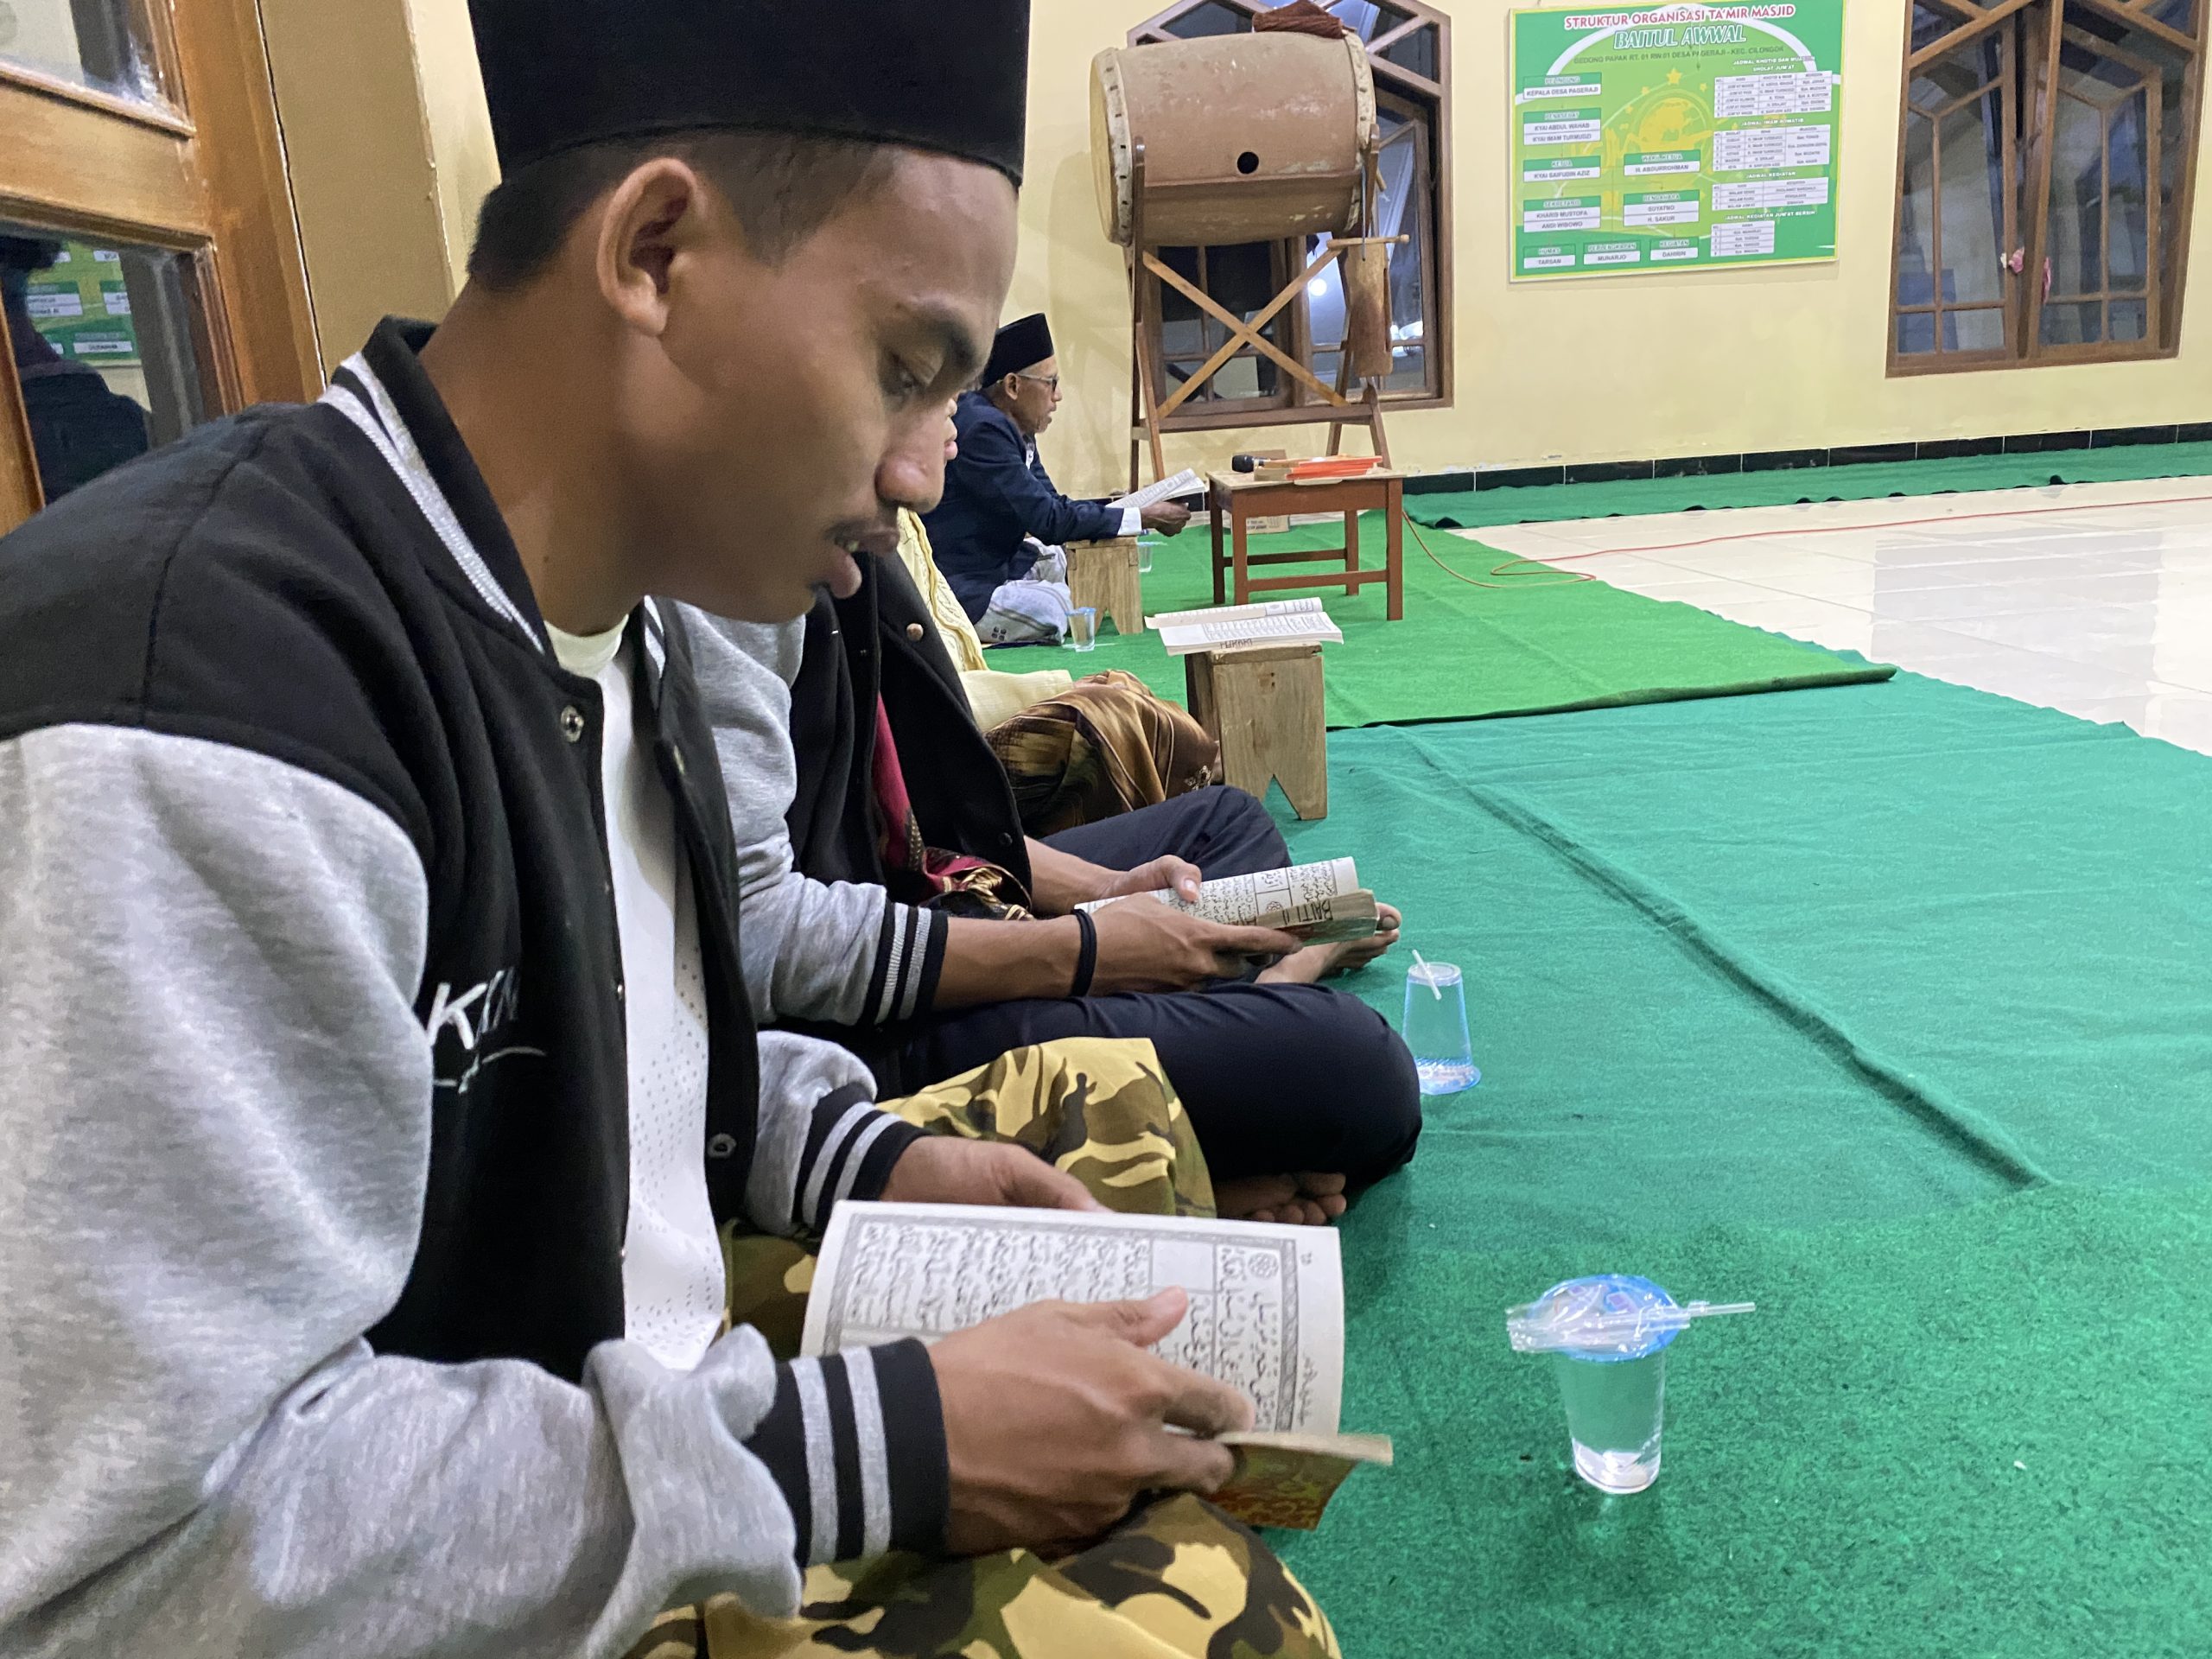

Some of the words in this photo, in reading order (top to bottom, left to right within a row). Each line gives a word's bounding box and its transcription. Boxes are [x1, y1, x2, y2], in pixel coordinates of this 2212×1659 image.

[1566, 14, 1628, 29] STRUKTUR
[1633, 10, 1705, 24] ORGANISASI
[1708, 8, 1747, 21] TA'MIR
[1751, 5, 1796, 17] MASJID
[1614, 29, 1676, 48] BAITUL
[1682, 25, 1746, 45] AWWAL
[1671, 50, 1690, 59] DESA
[1691, 48, 1726, 58] PAGERAJI
